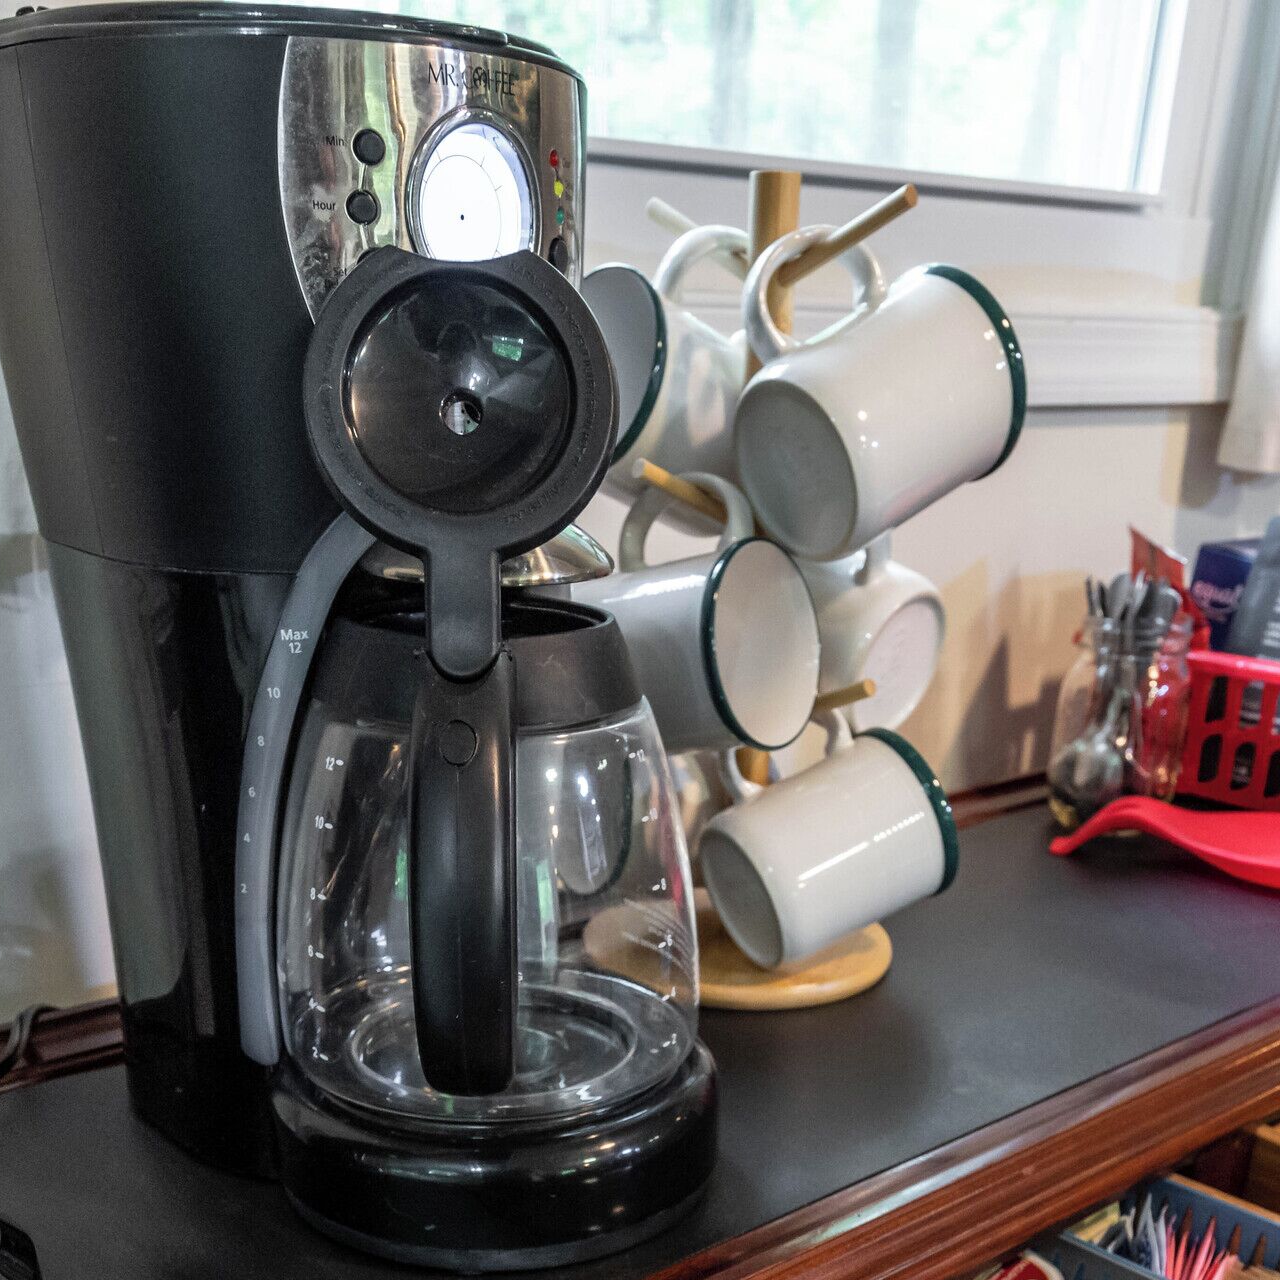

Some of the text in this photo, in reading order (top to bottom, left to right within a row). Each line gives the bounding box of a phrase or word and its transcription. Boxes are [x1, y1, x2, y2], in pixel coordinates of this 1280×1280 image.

[428, 62, 459, 87] MR.
[326, 136, 344, 146] Min
[313, 200, 336, 211] Hour
[280, 629, 309, 640] Max
[289, 642, 302, 654] 12
[267, 687, 280, 699] 10
[257, 736, 264, 746] 8
[326, 756, 334, 771] 12
[248, 786, 256, 798] 6
[315, 815, 324, 829] 10
[243, 833, 250, 843] 4
[240, 883, 247, 894] 2
